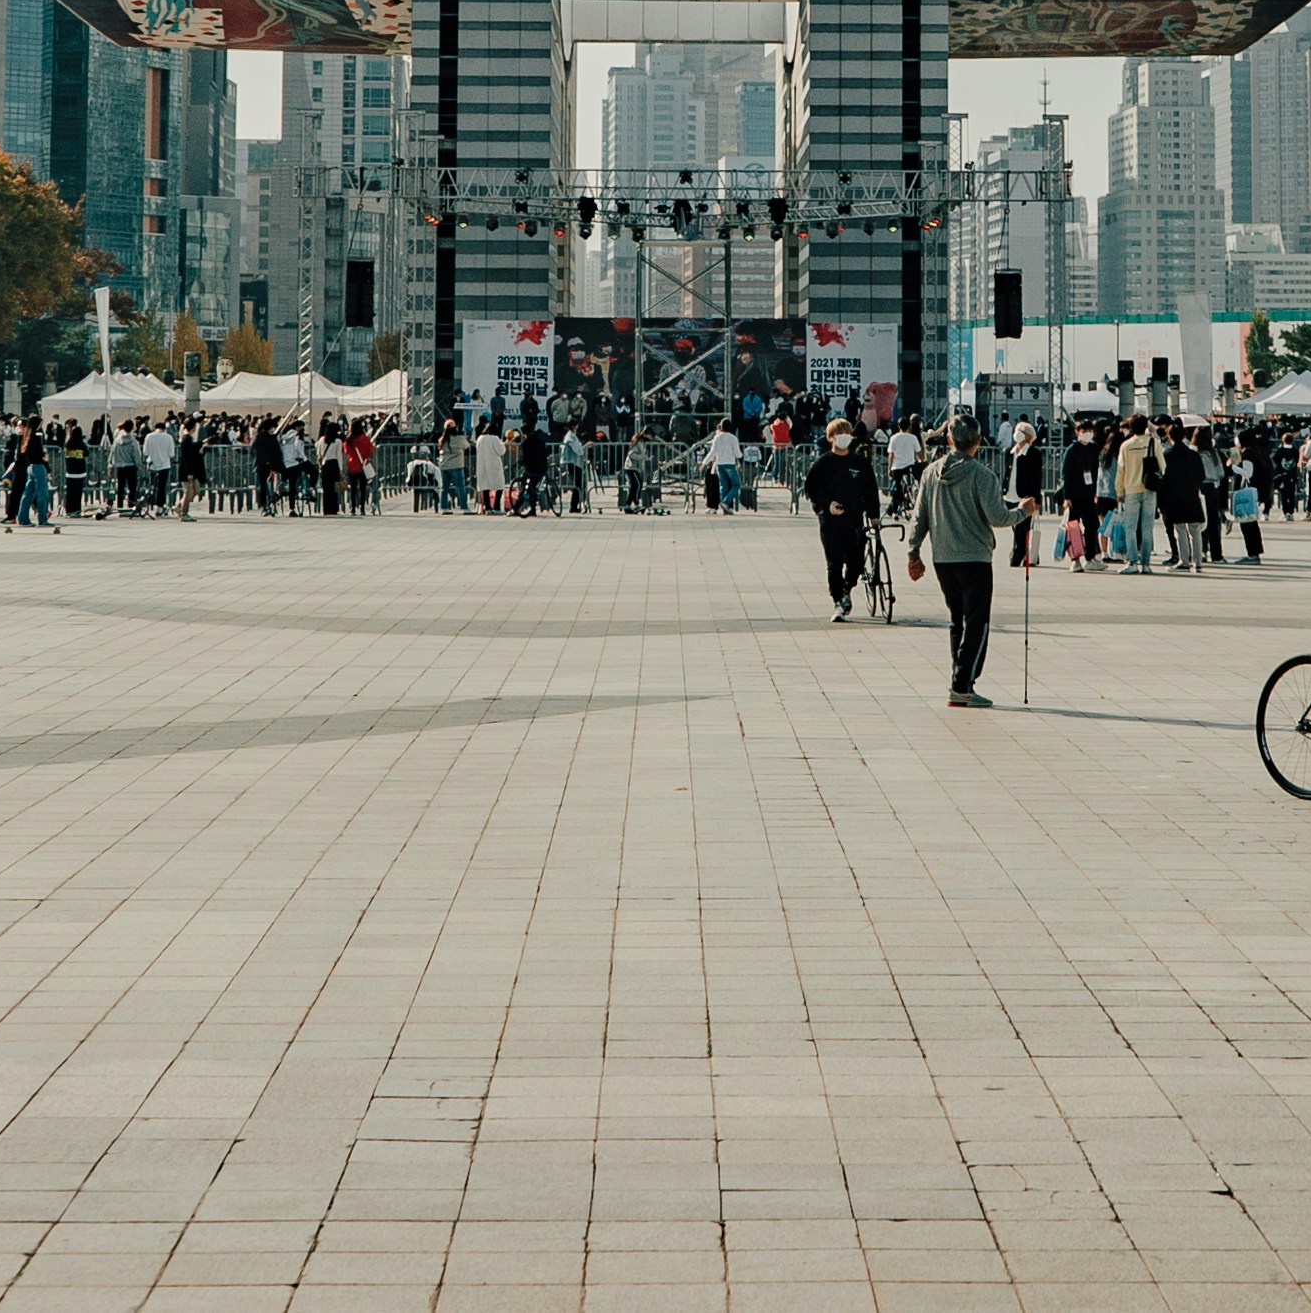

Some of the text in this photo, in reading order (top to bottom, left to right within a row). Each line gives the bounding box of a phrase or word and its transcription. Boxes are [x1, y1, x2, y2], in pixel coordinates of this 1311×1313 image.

[497, 355, 549, 367] 2021 제5회
[810, 357, 862, 368] 2021 제5회
[497, 366, 549, 382] 대한민국
[810, 369, 862, 383] 대한민국
